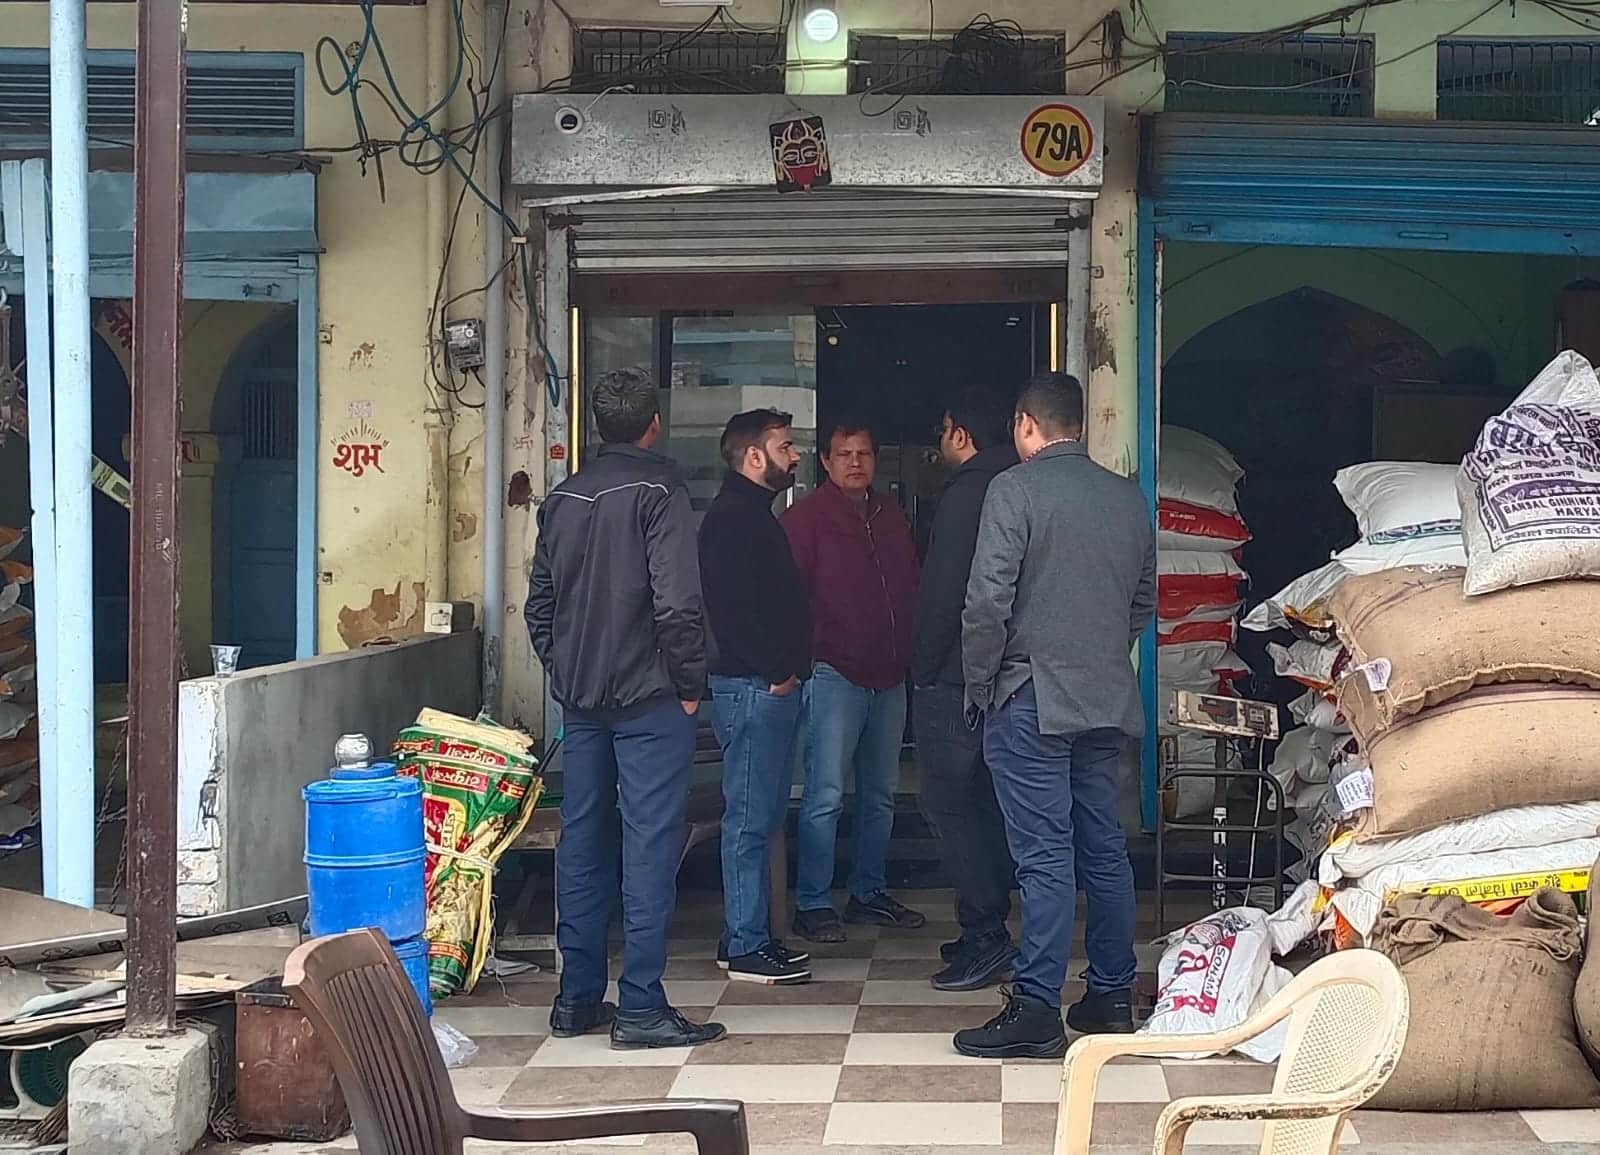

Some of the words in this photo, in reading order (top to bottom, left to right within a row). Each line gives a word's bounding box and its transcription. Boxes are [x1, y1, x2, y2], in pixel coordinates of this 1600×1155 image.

[1031, 122, 1083, 161] 79A
[1503, 499, 1549, 514] BANSAL
[1555, 507, 1600, 517] HARYA
[1206, 947, 1226, 995] SOHAM
